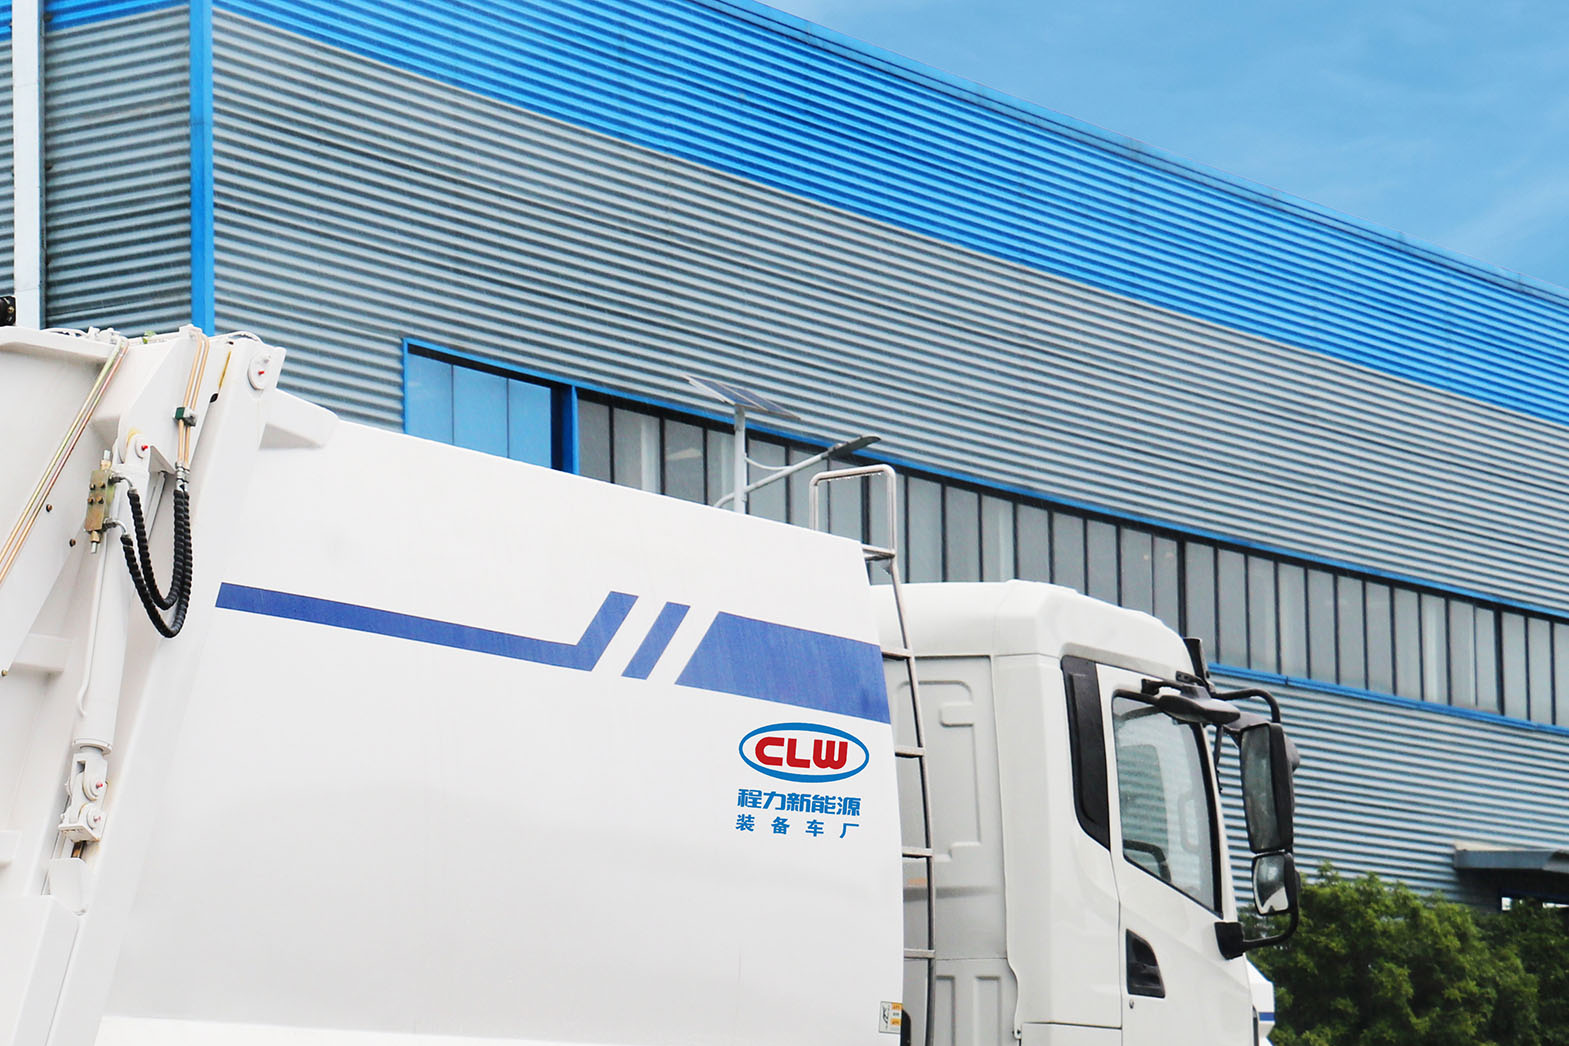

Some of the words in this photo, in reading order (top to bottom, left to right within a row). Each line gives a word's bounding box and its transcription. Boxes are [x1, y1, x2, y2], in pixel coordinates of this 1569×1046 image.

[754, 736, 849, 770] CLW
[736, 788, 862, 817] 程力新能源
[735, 814, 860, 839] 装备车厂
